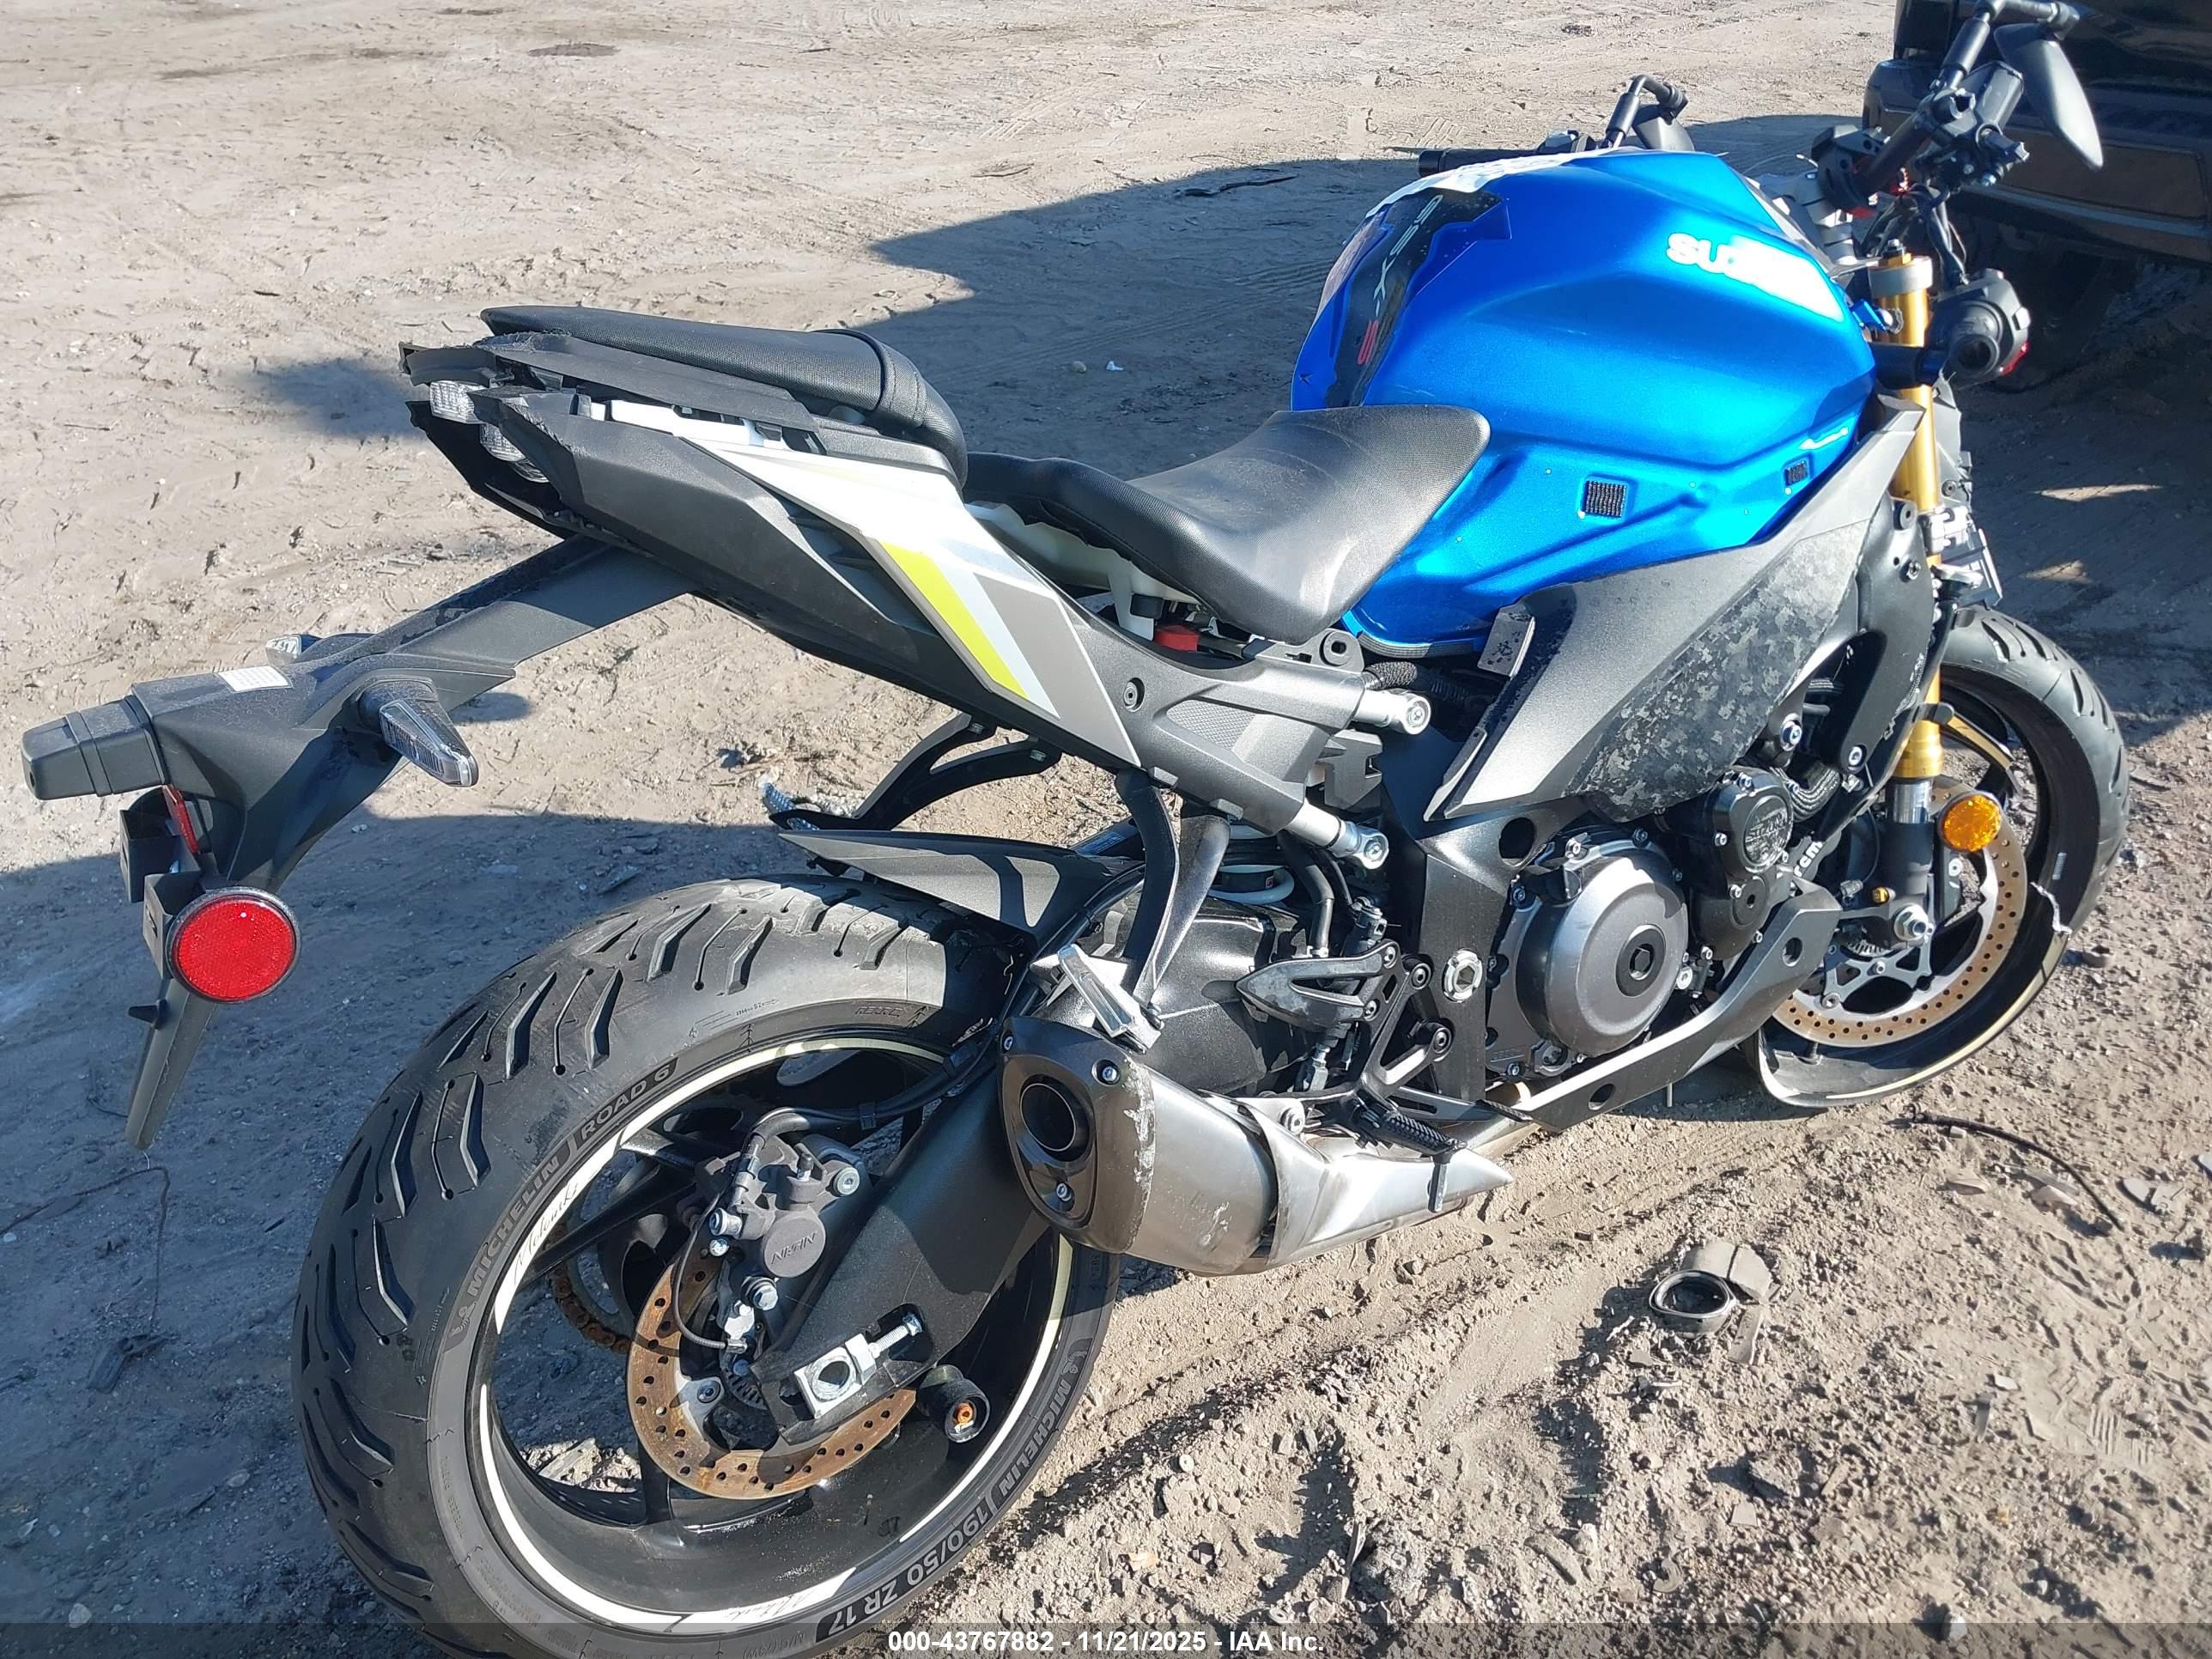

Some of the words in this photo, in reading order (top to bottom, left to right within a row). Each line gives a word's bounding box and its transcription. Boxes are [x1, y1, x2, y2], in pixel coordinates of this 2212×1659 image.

[1793, 841, 1824, 878] rem
[466, 1156, 561, 1297] MICHELIN
[580, 1080, 647, 1140] ROAD
[653, 1064, 670, 1082] 6
[998, 1379, 1073, 1495] MICHELIN
[907, 1495, 990, 1585] 190/50
[828, 1607, 858, 1636] 17
[864, 1582, 899, 1615] ZR
